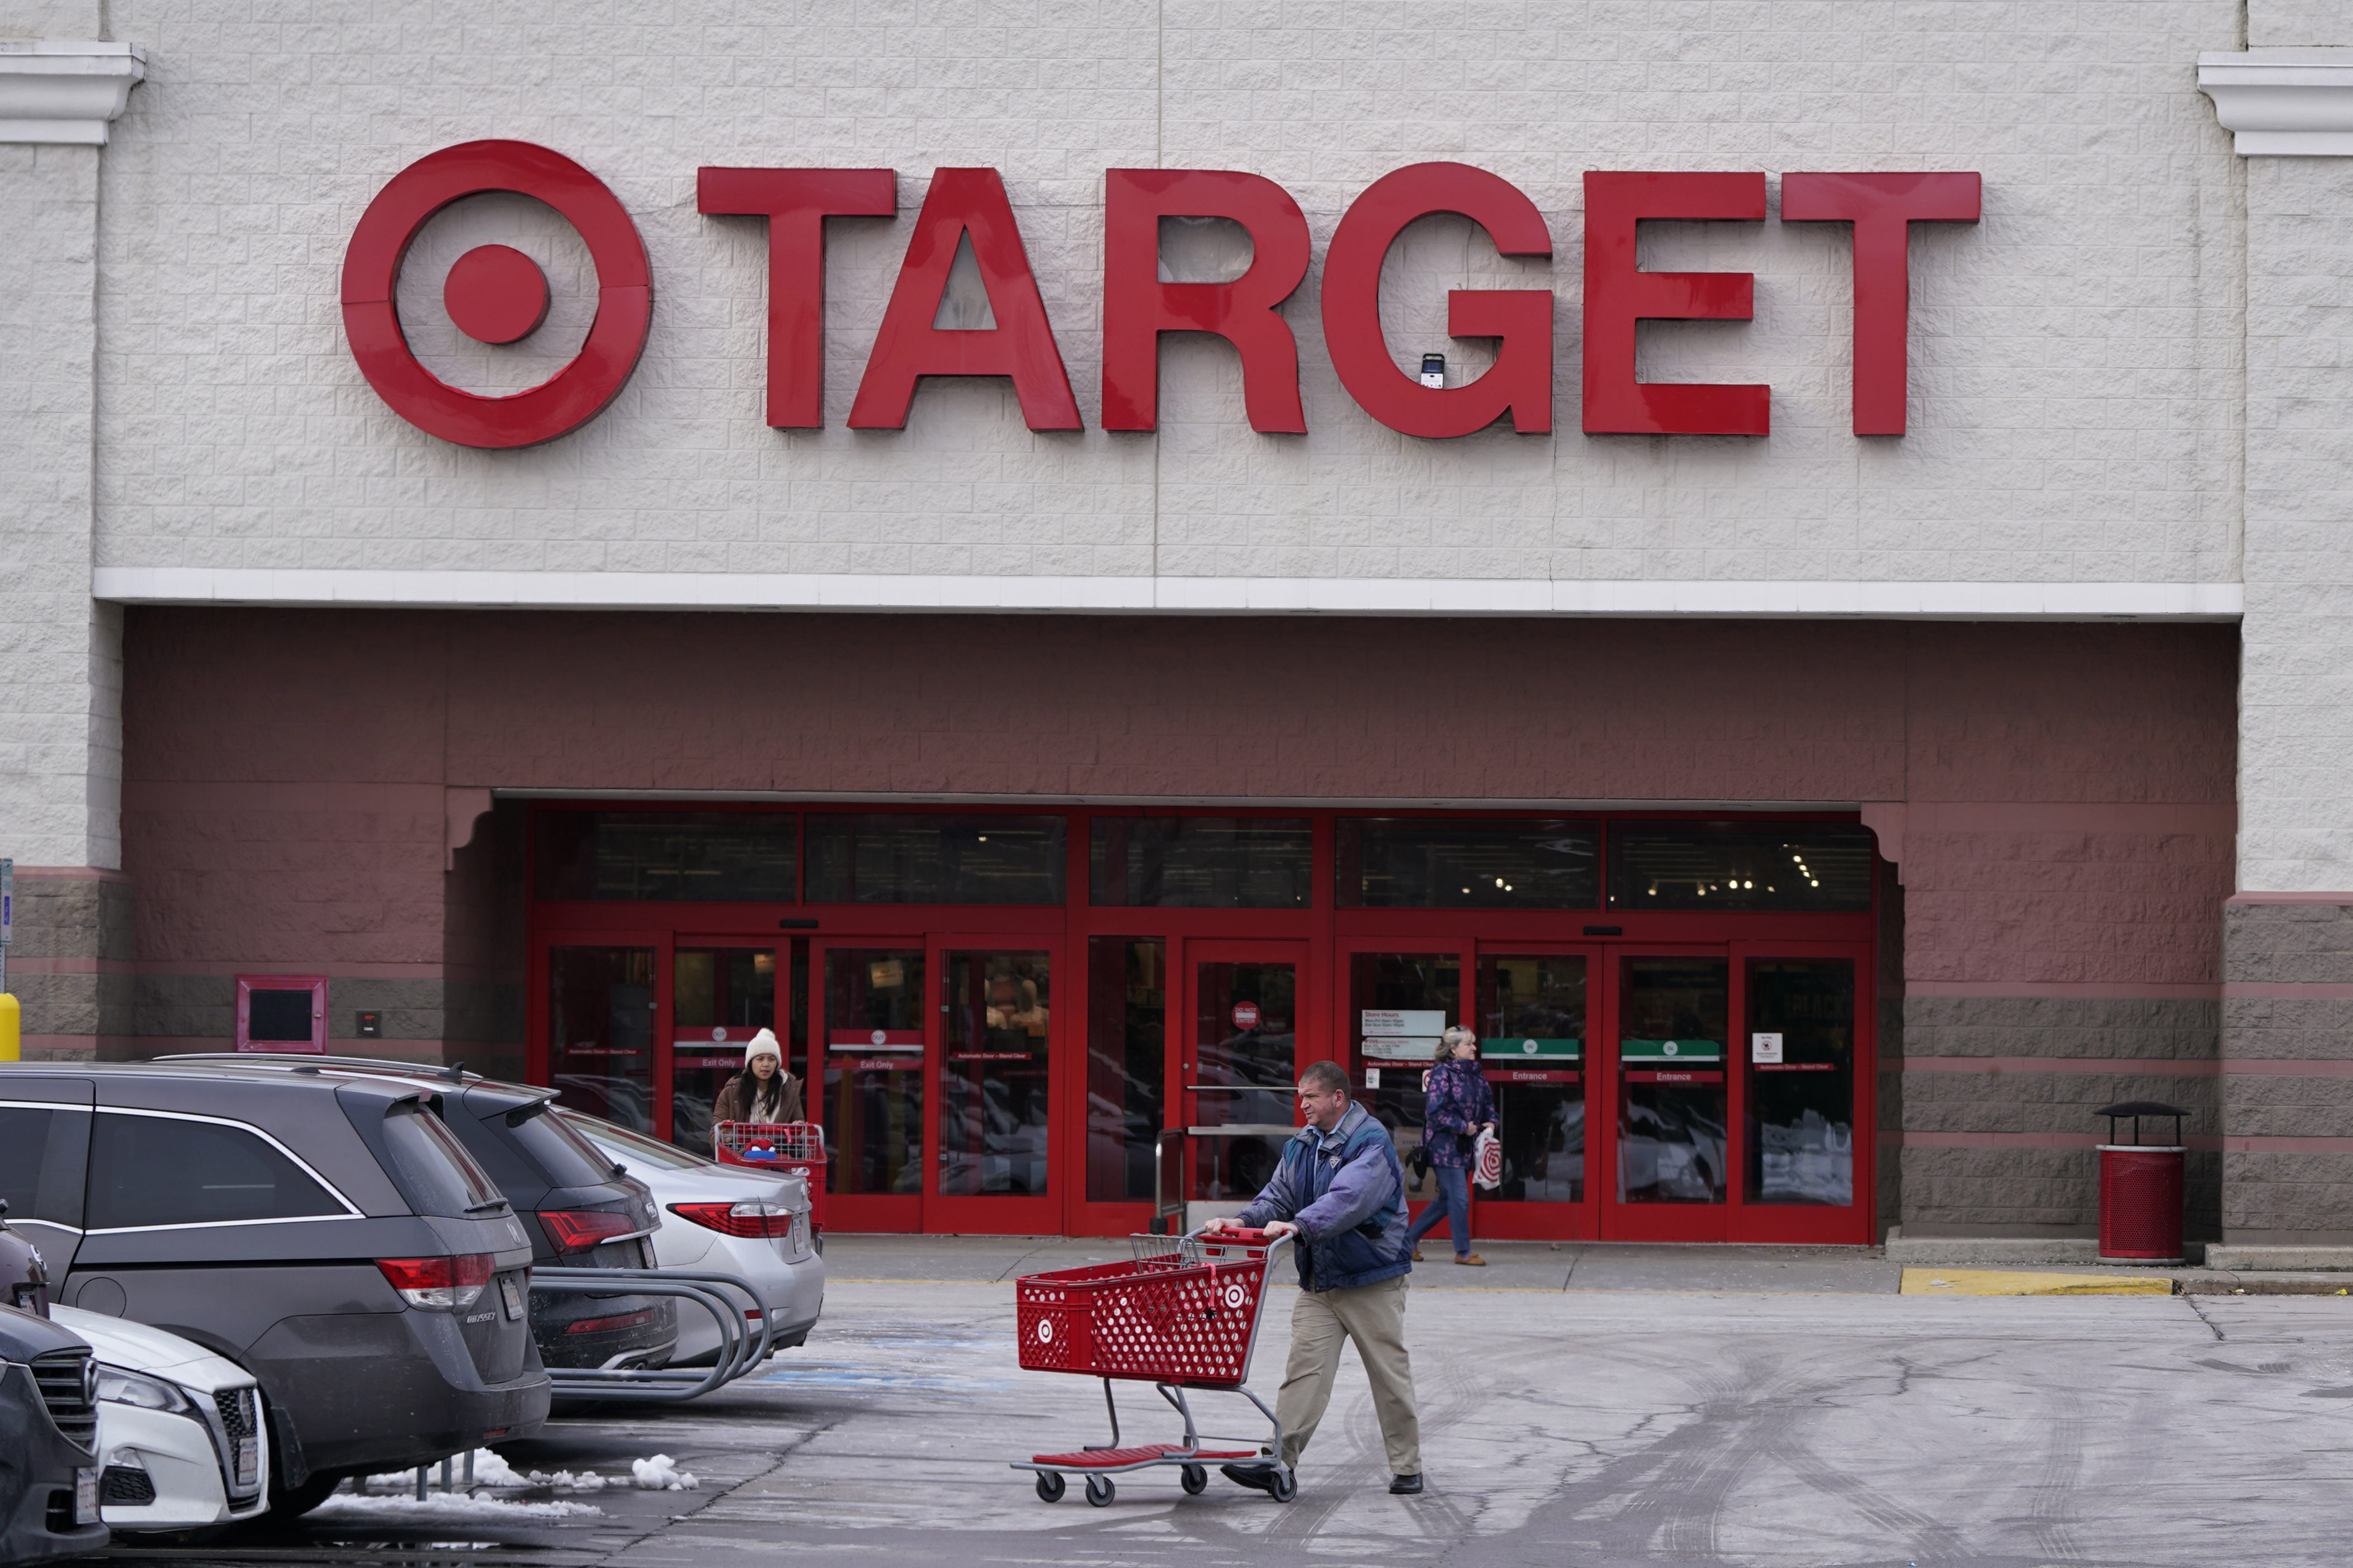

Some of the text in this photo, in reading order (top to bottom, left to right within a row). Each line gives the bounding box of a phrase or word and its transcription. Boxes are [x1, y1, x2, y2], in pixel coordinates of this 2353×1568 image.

[697, 162, 1981, 438] TARGET
[719, 1059, 735, 1068] Only
[876, 1061, 893, 1070] Only
[1657, 1072, 1691, 1081] Entrance
[467, 1312, 496, 1324] ODYSSEY
